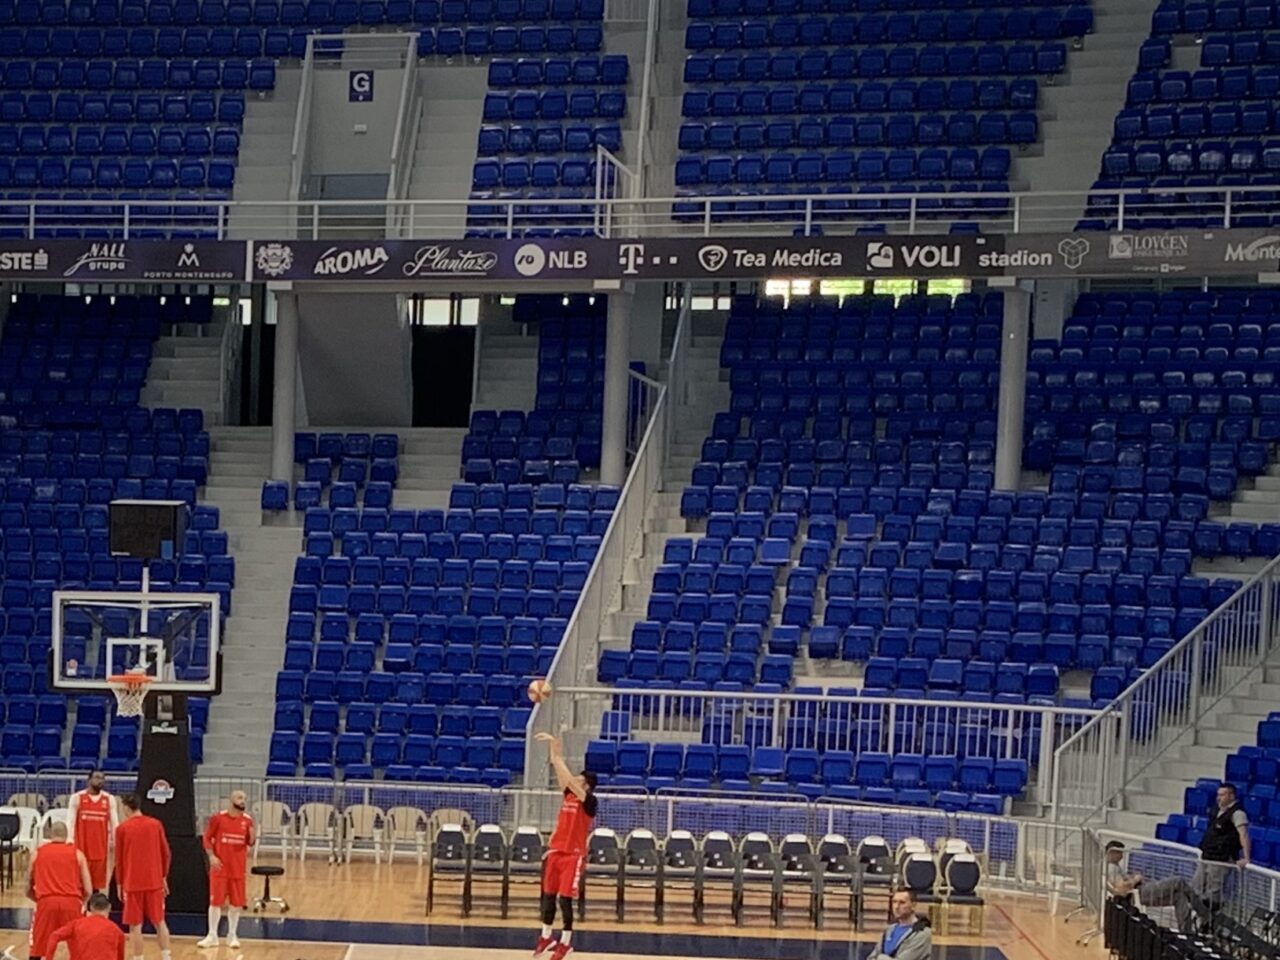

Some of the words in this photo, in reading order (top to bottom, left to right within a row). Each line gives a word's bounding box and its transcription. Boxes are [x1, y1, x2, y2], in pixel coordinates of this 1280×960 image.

[352, 72, 370, 92] G
[1134, 231, 1189, 250] LOVĆEN
[88, 261, 126, 271] grupa
[314, 246, 390, 274] AROMA
[548, 250, 588, 269] NLB
[732, 249, 766, 267] Tea
[771, 249, 843, 267] Medica
[900, 245, 961, 268] VOLI
[978, 250, 1053, 267] stadion
